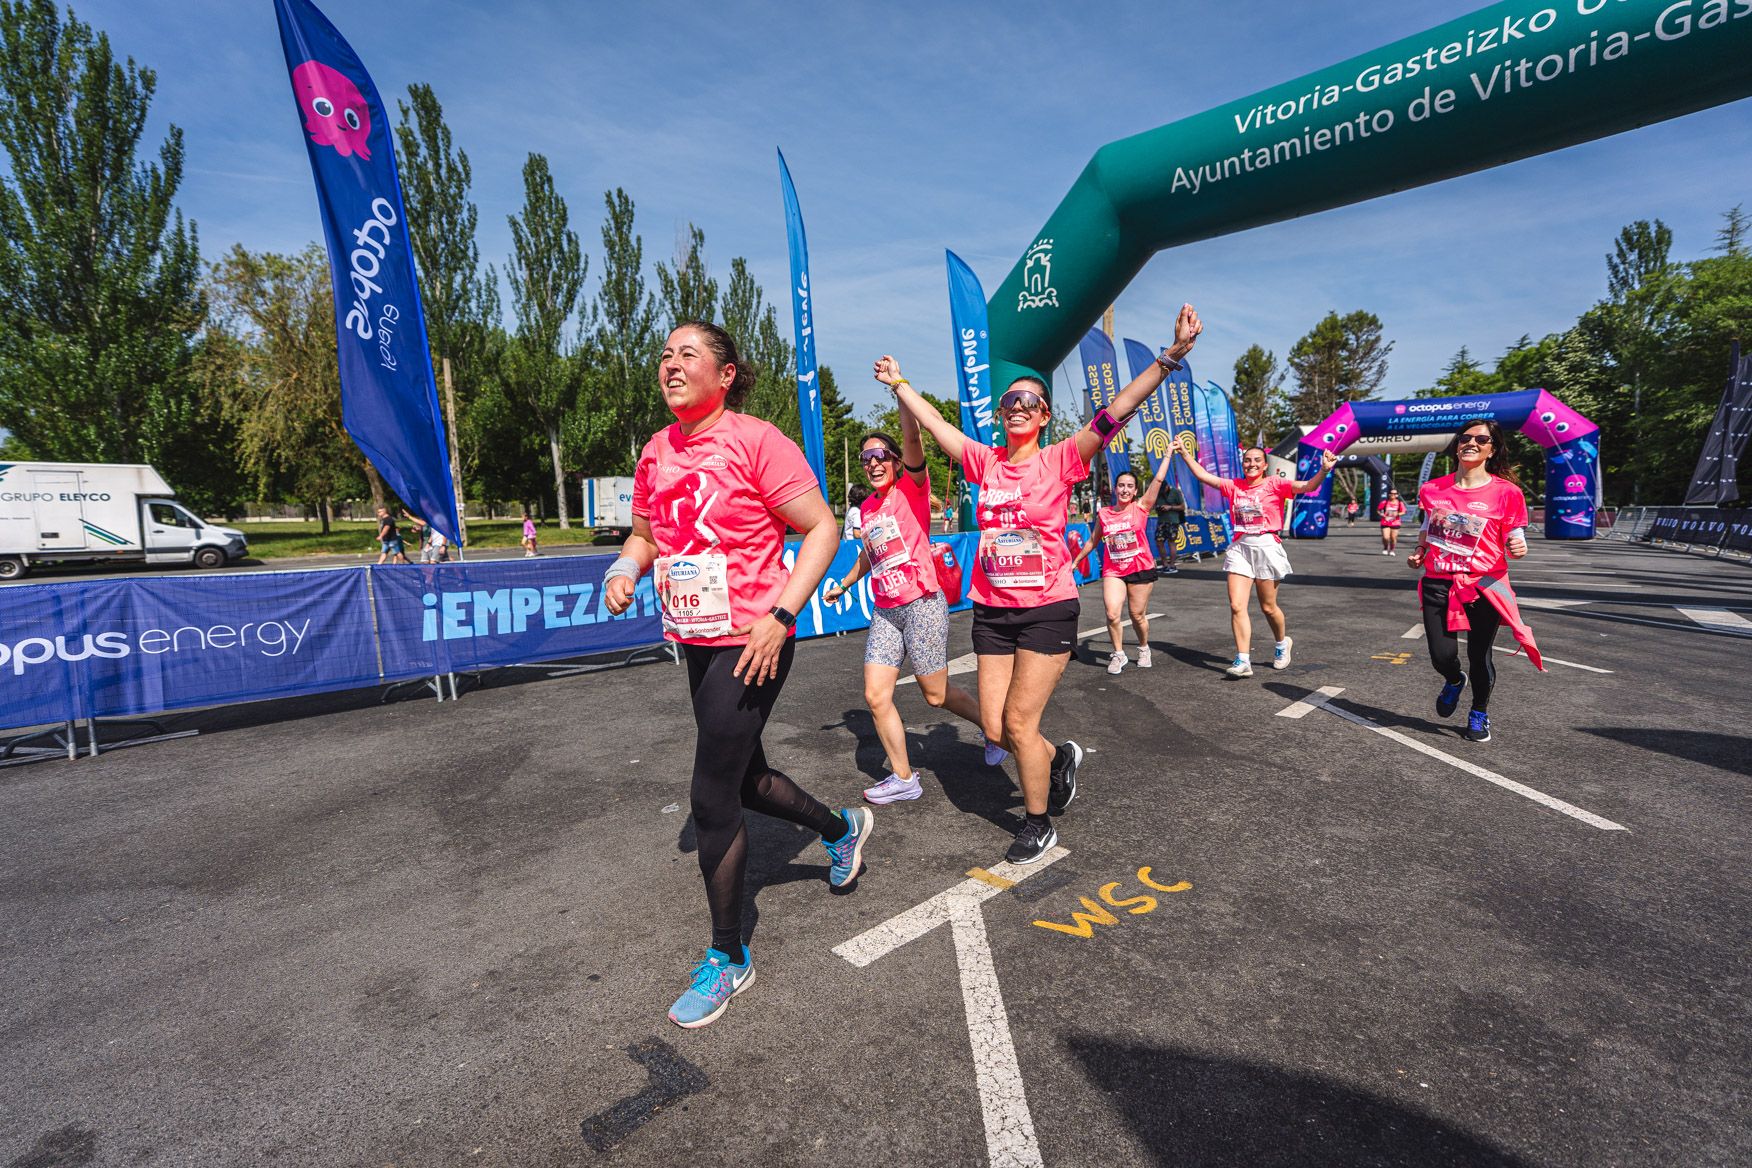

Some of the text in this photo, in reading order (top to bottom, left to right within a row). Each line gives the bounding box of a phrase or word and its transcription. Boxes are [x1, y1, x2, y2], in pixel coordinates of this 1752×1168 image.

[1233, 8, 1557, 135] Vitoria-Gasteizko
[1170, 108, 1394, 194] Ayuntamiento
[1407, 86, 1456, 122] de
[1408, 401, 1491, 413] octopus energy
[1400, 414, 1435, 424] ENERGÍA
[1460, 412, 1495, 420] CORRER
[1, 493, 111, 502] GRUPO ELEYCO
[620, 493, 635, 502] ev
[1682, 521, 1725, 532] VOLVO
[998, 556, 1023, 566] 016
[672, 593, 700, 609] 016
[139, 618, 311, 657] energy
[1032, 866, 1193, 939] WSC
